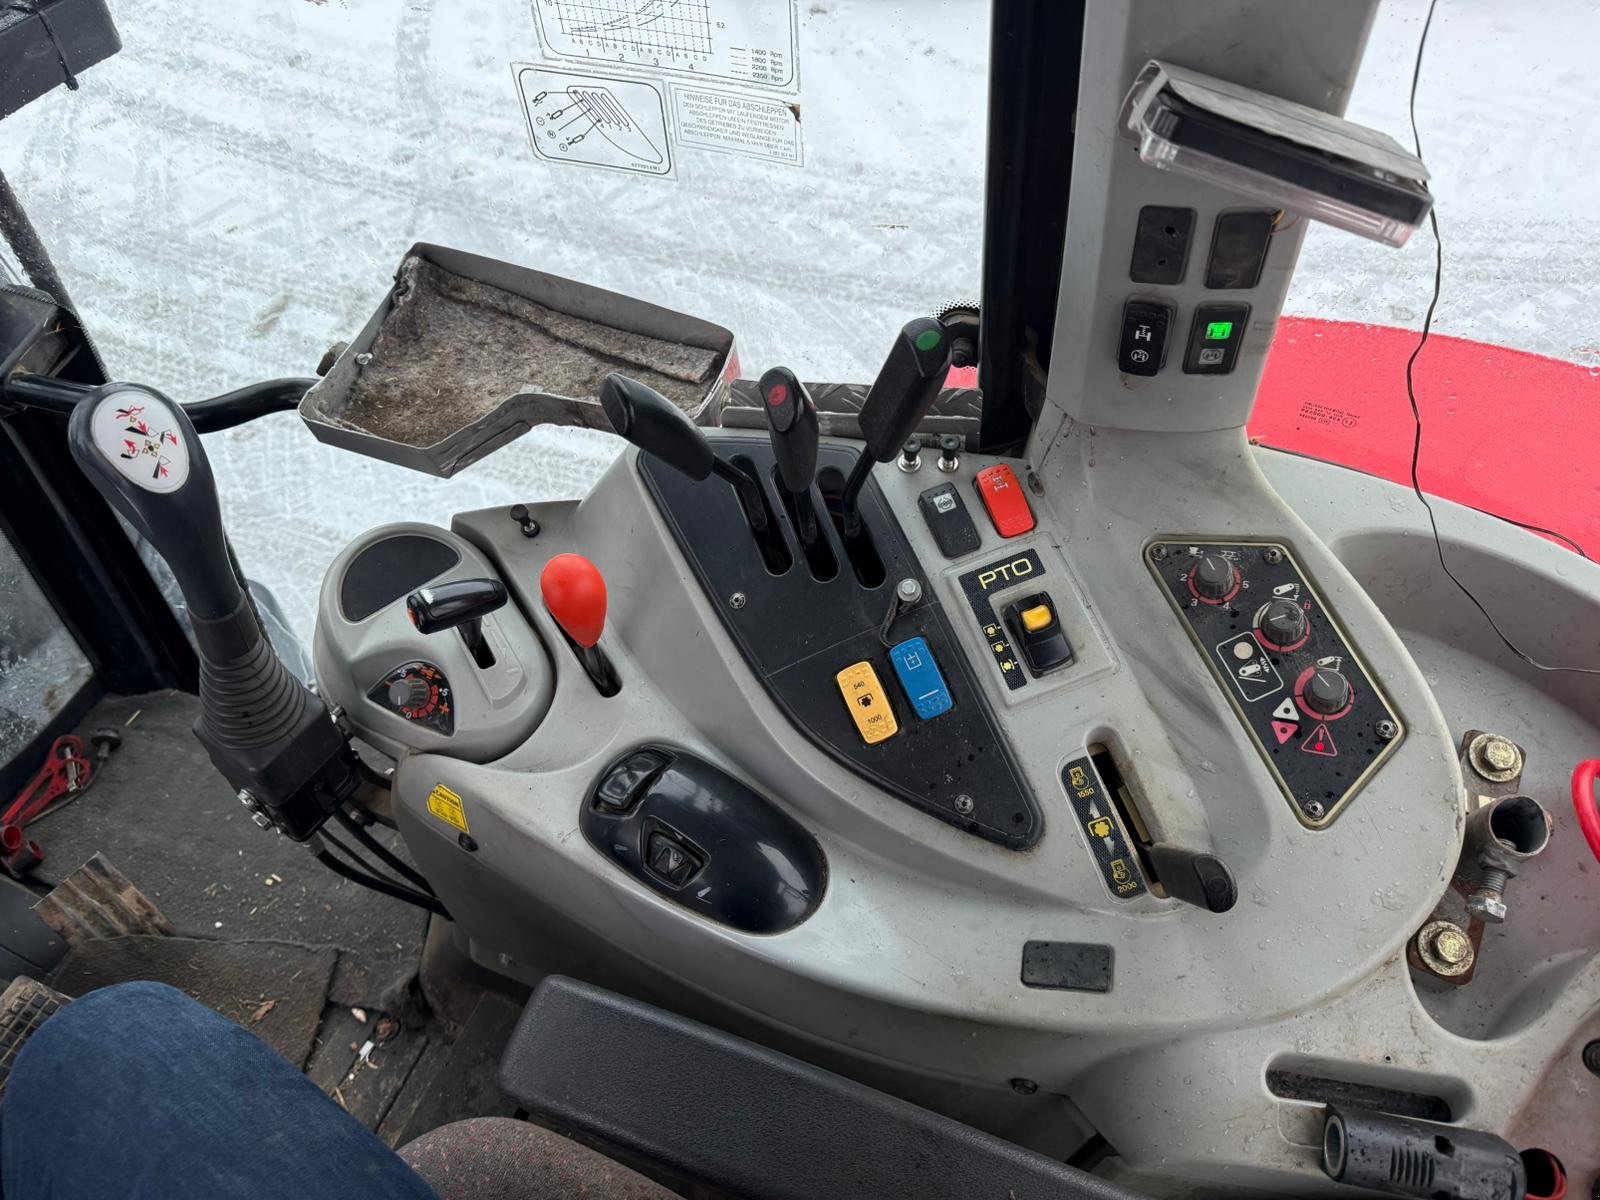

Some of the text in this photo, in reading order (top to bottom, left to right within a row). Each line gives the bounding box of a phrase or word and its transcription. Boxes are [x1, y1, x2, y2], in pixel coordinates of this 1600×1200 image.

[751, 48, 766, 56] 1400
[683, 92, 713, 104] HINWEISE
[728, 99, 741, 109] DAS
[742, 101, 786, 117] ABSCHLEPPEN
[978, 558, 1033, 590] PTO
[1179, 573, 1188, 582] 2
[1242, 580, 1250, 589] 5
[1190, 598, 1198, 607] 3
[1223, 601, 1230, 610] 4
[853, 681, 865, 690] 540
[405, 711, 412, 720] 0
[867, 714, 882, 724] 1000
[435, 788, 459, 808] CAUTION
[1117, 881, 1137, 893] 2000
